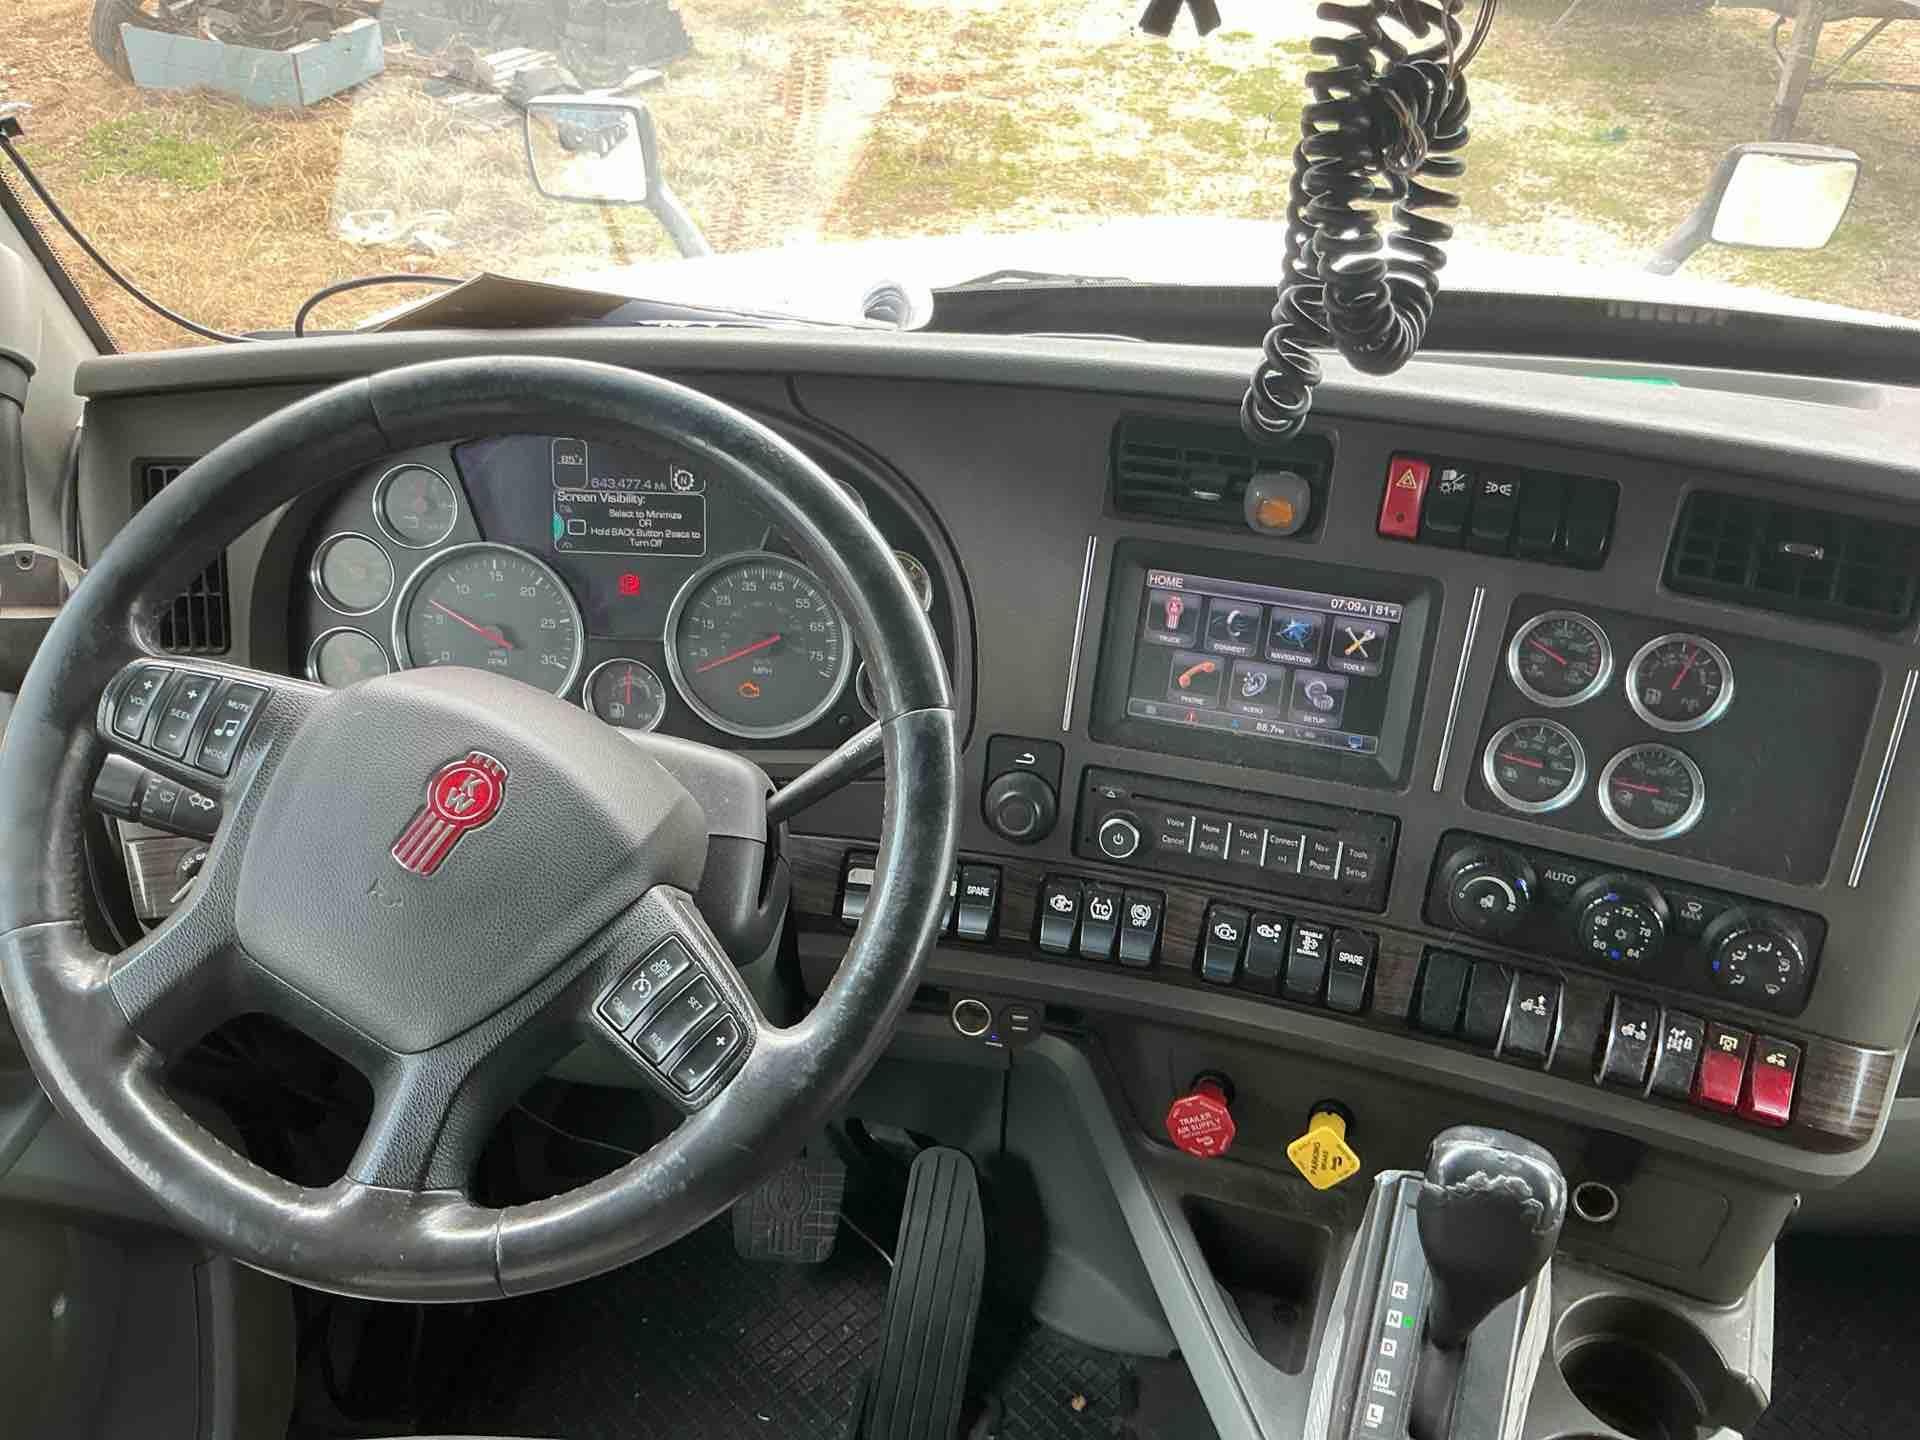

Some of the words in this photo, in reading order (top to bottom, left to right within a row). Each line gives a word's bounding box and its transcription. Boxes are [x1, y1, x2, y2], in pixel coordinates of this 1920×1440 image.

[558, 491, 597, 503] Screen
[600, 493, 646, 506] Visibility:
[608, 508, 634, 519] Select
[636, 509, 645, 519] to
[646, 510, 682, 520] Minimize
[638, 519, 653, 528] OR
[590, 527, 609, 537] Hold
[611, 527, 634, 537] BACK
[636, 529, 664, 538] Button
[691, 531, 701, 539] to
[630, 538, 649, 548] Turn
[650, 538, 663, 548] Off
[489, 571, 504, 582] 15
[1149, 574, 1184, 588] HOME
[456, 584, 471, 595] 10
[519, 586, 536, 597] 20
[742, 581, 757, 592] 35
[769, 582, 784, 592] 45
[716, 595, 731, 606] 25
[795, 598, 810, 609] 55
[540, 619, 556, 630] 25
[702, 620, 714, 631] 15
[809, 622, 825, 633] 65
[1214, 643, 1246, 654] CONNECT
[540, 655, 560, 666] 30
[809, 650, 824, 662] 75
[1271, 652, 1312, 664] NAVIGATION
[752, 665, 773, 676] MPH
[1343, 662, 1365, 673] TOOLS
[130, 696, 145, 706] VOL
[228, 700, 249, 713] MUTE
[171, 708, 191, 720] SEEK
[1303, 714, 1326, 725] SETUP
[1166, 817, 1185, 827] Voice
[1202, 823, 1220, 833] Home
[1161, 834, 1185, 846] Cancel
[1239, 829, 1257, 840] Truck
[1269, 834, 1299, 847] Connect
[1200, 841, 1218, 852] Audio
[1349, 848, 1368, 859] Tools
[1309, 859, 1331, 871] Phone
[1345, 866, 1368, 878] Setup
[1544, 868, 1576, 885] AUTO
[967, 885, 989, 897] SPARE
[1094, 903, 1109, 916] TC
[1622, 906, 1634, 918] 72
[1132, 919, 1148, 928] OFF
[1639, 926, 1651, 937] 78
[1593, 940, 1606, 950] 60
[1339, 951, 1364, 967] SPARE
[1627, 948, 1640, 960] 84
[1179, 1112, 1212, 1126] TRAILER
[1190, 1117, 1221, 1132] SUPPLY
